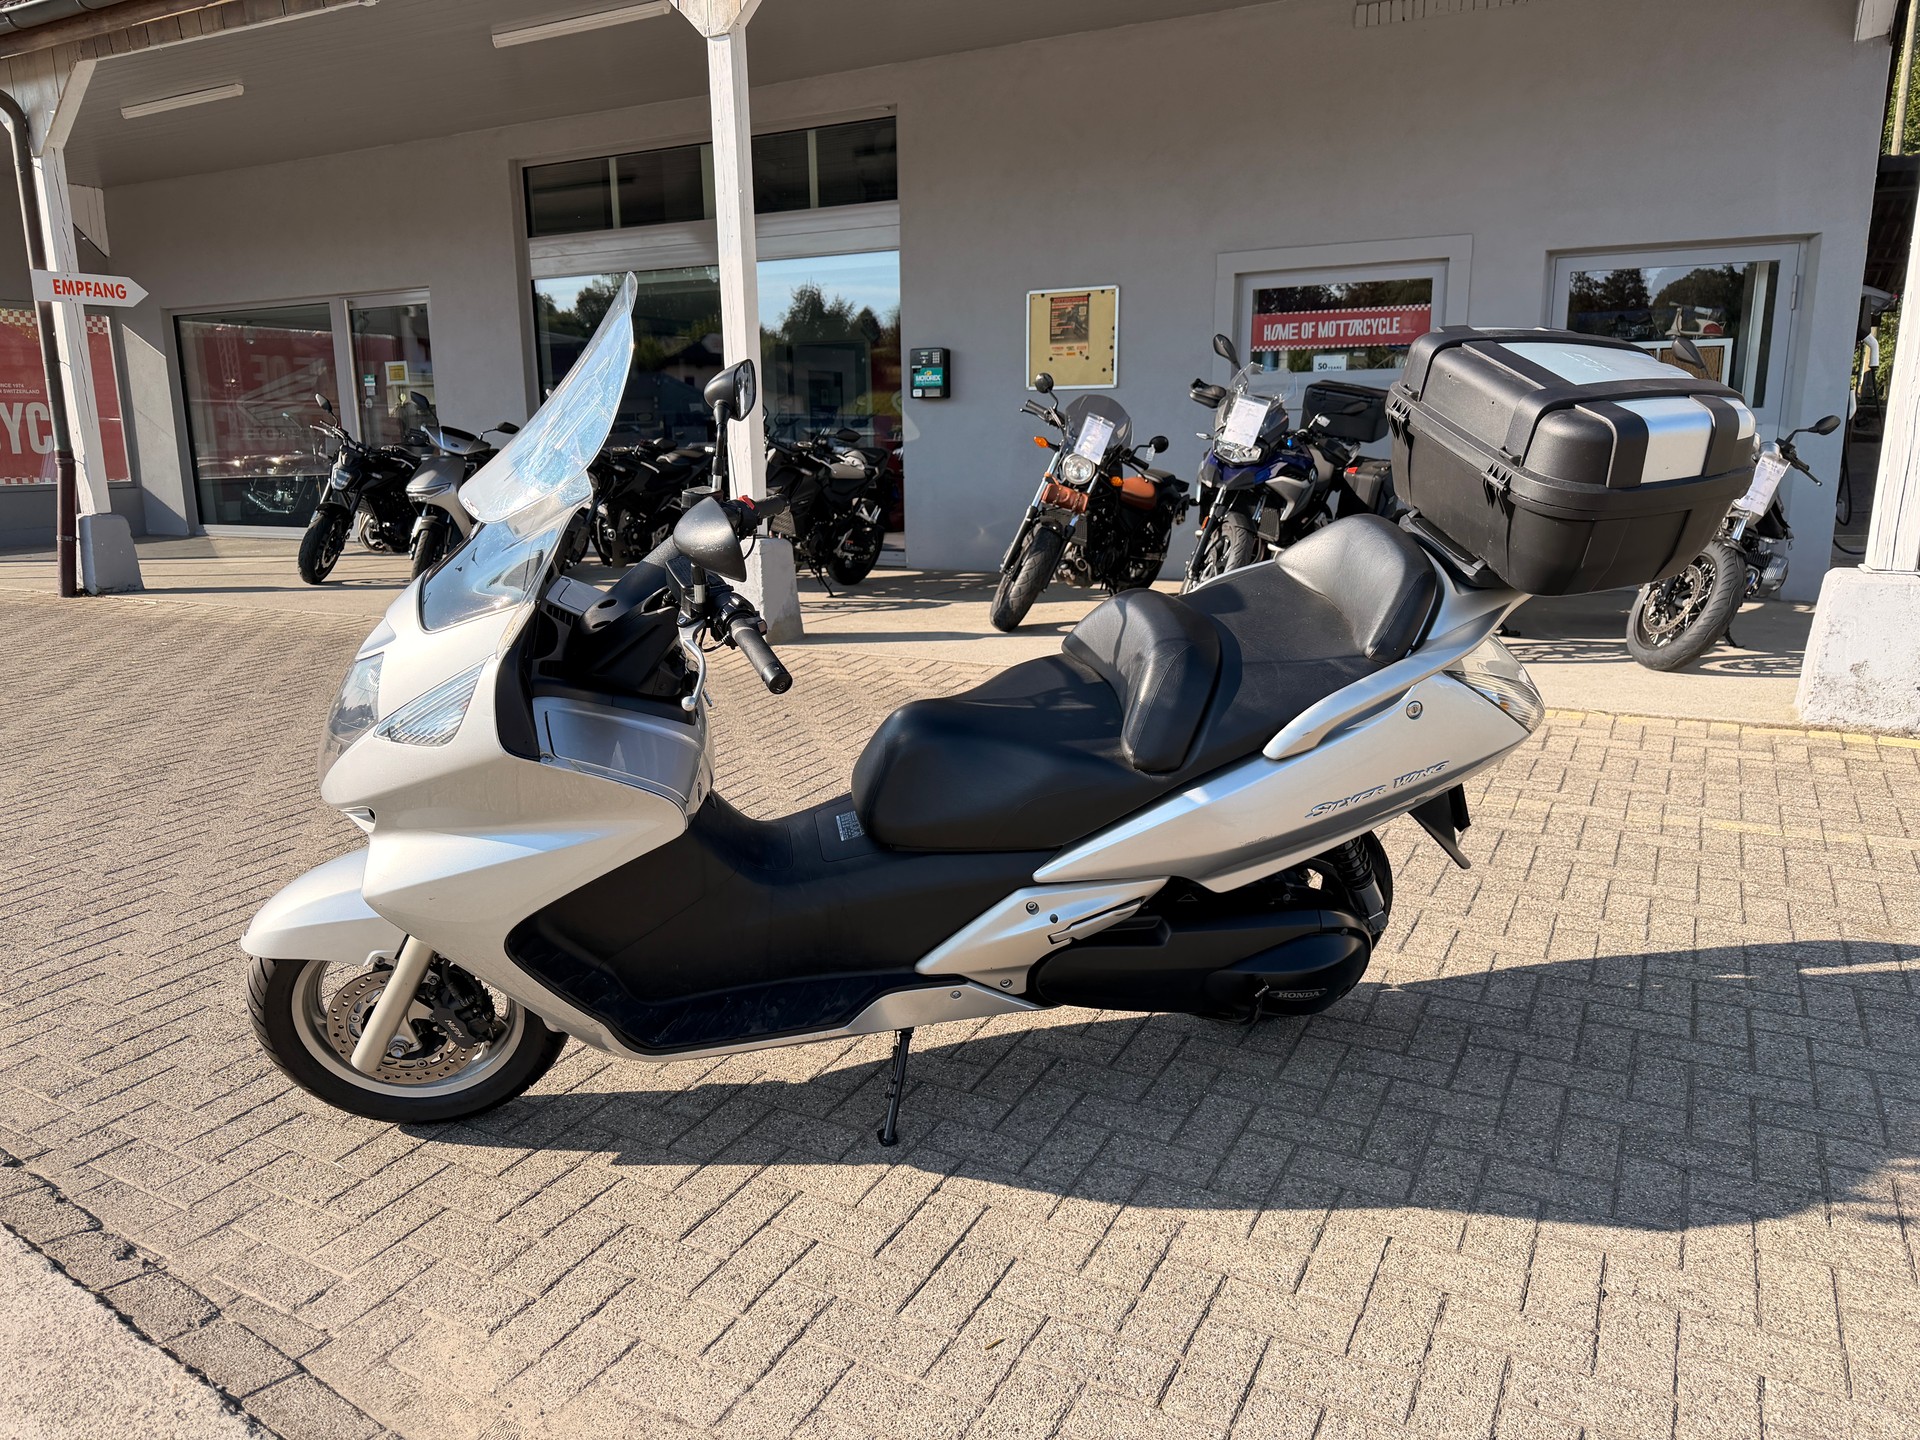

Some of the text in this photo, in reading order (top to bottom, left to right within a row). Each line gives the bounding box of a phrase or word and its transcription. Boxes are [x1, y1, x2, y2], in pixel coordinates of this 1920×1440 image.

[52, 279, 127, 300] EMPFANG
[1263, 316, 1401, 342] HOME OF MOTORCYCLE
[1317, 362, 1328, 370] 50
[1305, 760, 1450, 818] SILVER WING
[1278, 991, 1320, 999] HONDA
